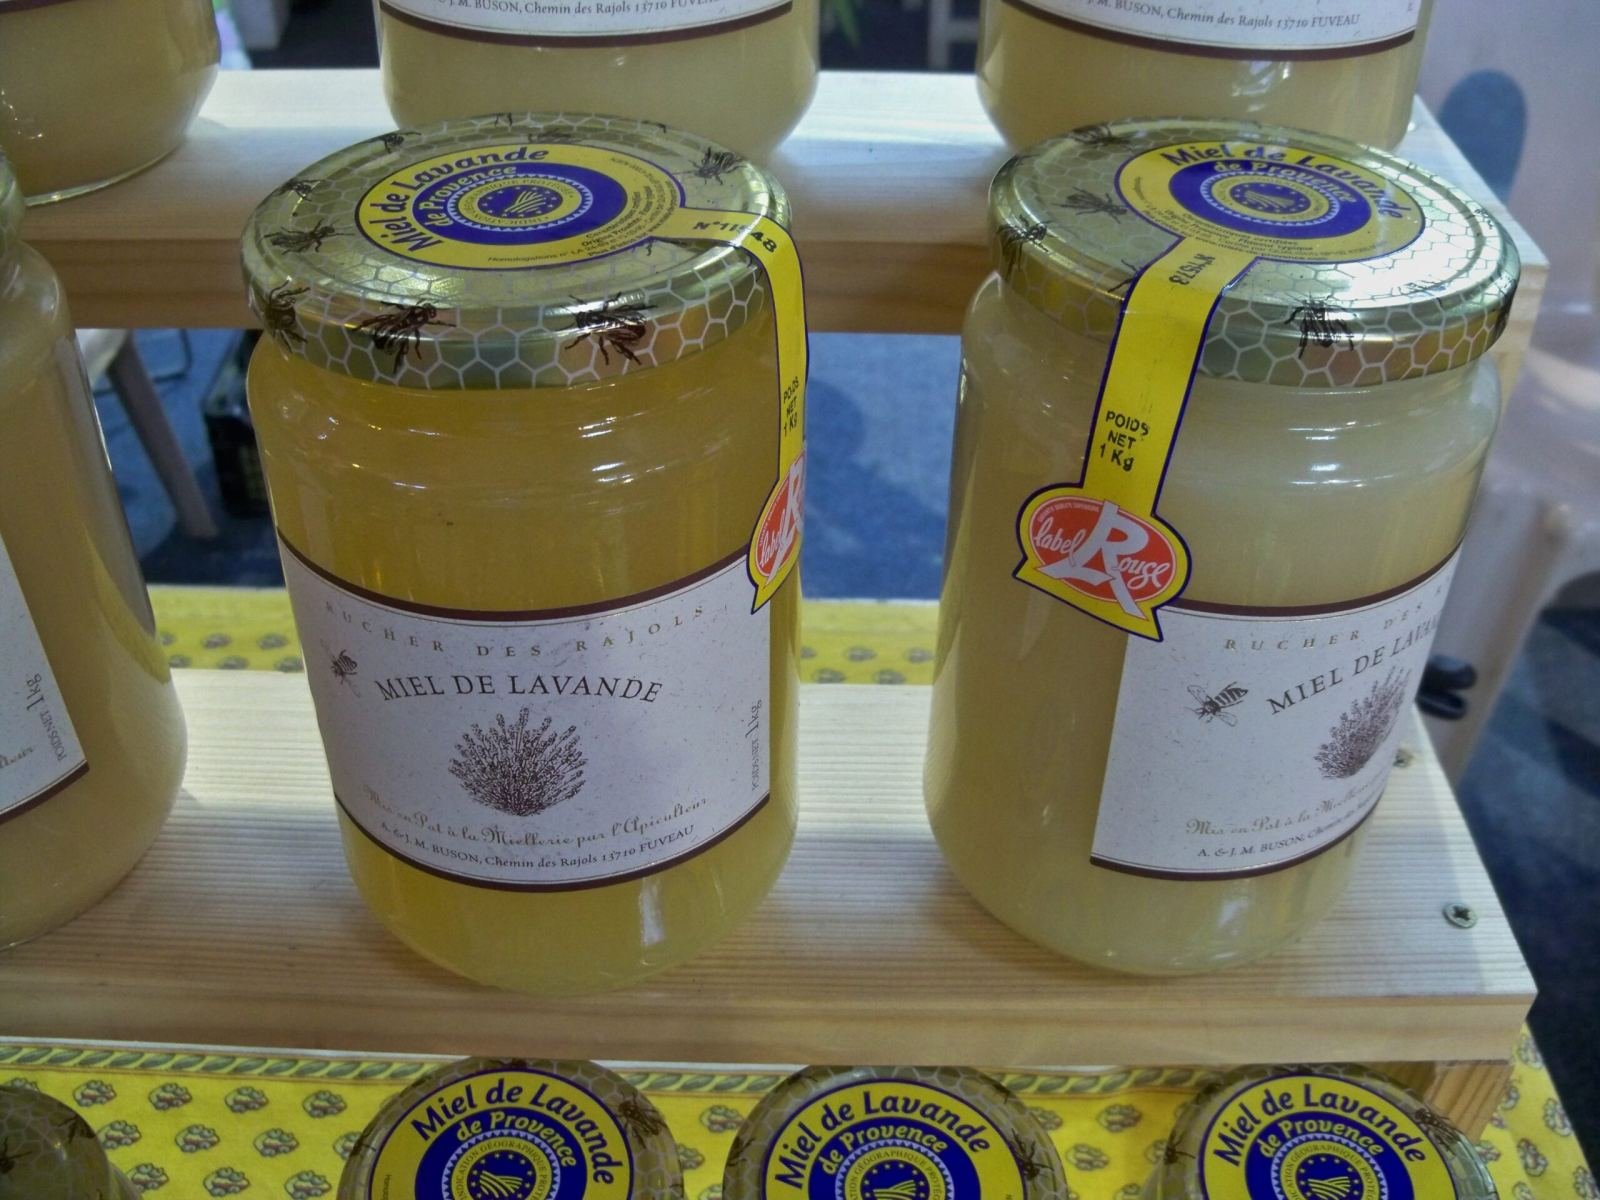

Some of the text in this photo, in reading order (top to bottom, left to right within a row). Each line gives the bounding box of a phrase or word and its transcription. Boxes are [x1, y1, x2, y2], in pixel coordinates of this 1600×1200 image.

[475, 0, 522, 14] BUSON,
[524, 3, 571, 15] Chemin
[574, 3, 592, 14] des
[596, 3, 631, 16] Rajols
[635, 2, 668, 15] 13710
[1114, 0, 1164, 18] BUSON,
[1166, 8, 1214, 24] Chemin
[1217, 12, 1235, 24] des
[1238, 14, 1273, 29] Rajols
[1276, 17, 1308, 30] 13710
[1311, 14, 1361, 28] FUVEAU
[1160, 143, 1234, 167] Miel
[1243, 145, 1286, 160] de
[369, 146, 550, 252] Miel de Lavande
[418, 166, 518, 227] de Provence
[1213, 161, 1242, 173] de
[1251, 162, 1357, 204] Provence
[1105, 411, 1150, 436] POIDS
[1107, 430, 1137, 450] NET
[1100, 444, 1134, 472] 1 Kg
[1033, 516, 1087, 567] label
[325, 601, 704, 657] RUCHER DES RAJOLS
[1223, 601, 1423, 650] RUCHER DES
[26, 672, 45, 712] 1kg
[374, 675, 663, 703] MIEL DE LAVANDE
[1265, 667, 1344, 716] MIEL
[1351, 646, 1386, 677] DE
[432, 844, 483, 864] BUSON,
[484, 856, 534, 868] Chemin
[537, 855, 557, 867] des
[560, 854, 598, 868] Rajols
[602, 847, 636, 862] 13710
[640, 824, 694, 852] FUVEAU
[576, 832, 605, 848] par
[1185, 817, 1224, 836] Mis
[411, 1078, 623, 1185] Miel de Lavande
[456, 1111, 577, 1167] de Provence
[775, 1091, 991, 1190] Miel de Lavande
[1213, 1084, 1427, 1167] Miel de Lavande
[1257, 1118, 1384, 1158] de Provence
[819, 1125, 948, 1174] de Provence
